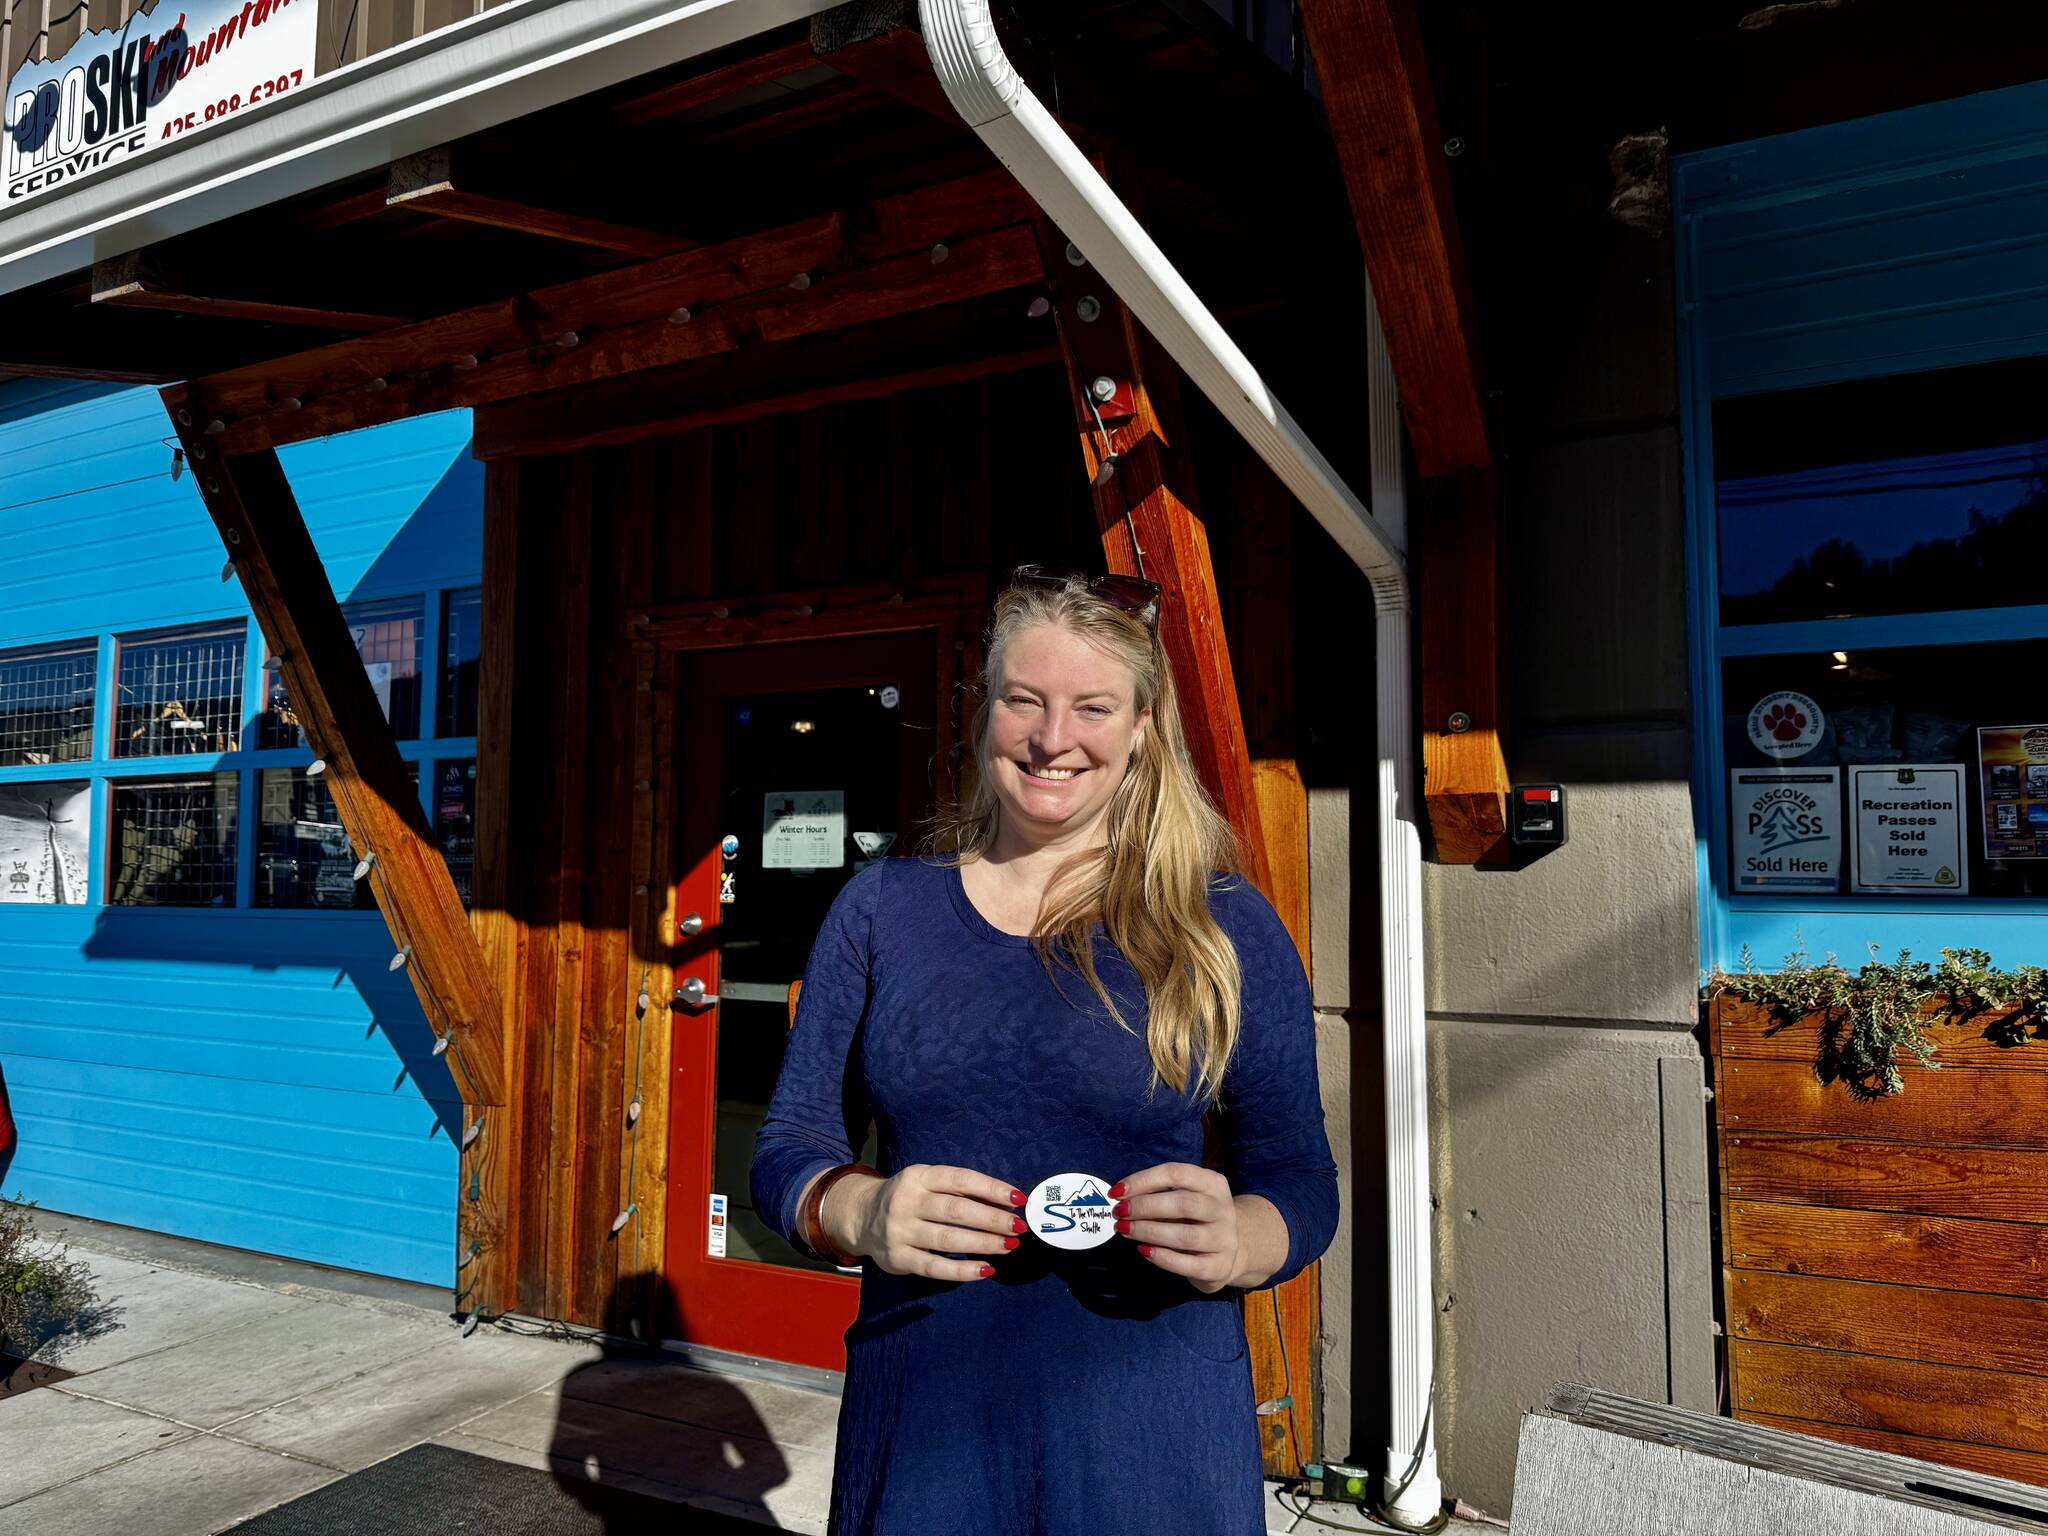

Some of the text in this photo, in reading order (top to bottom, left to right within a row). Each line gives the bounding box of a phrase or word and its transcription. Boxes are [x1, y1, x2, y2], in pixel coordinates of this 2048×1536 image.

[1752, 788, 1817, 811] DISCOVER
[1862, 800, 1953, 810] Recreation
[1878, 815, 1937, 826] Passes
[779, 825, 828, 833] Winter Hours
[1889, 830, 1926, 841] Sold
[1888, 845, 1928, 856] Here
[1746, 857, 1828, 872] Sold Here
[1069, 1208, 1112, 1219] To The Mountain
[1080, 1222, 1101, 1234] Shuttle
